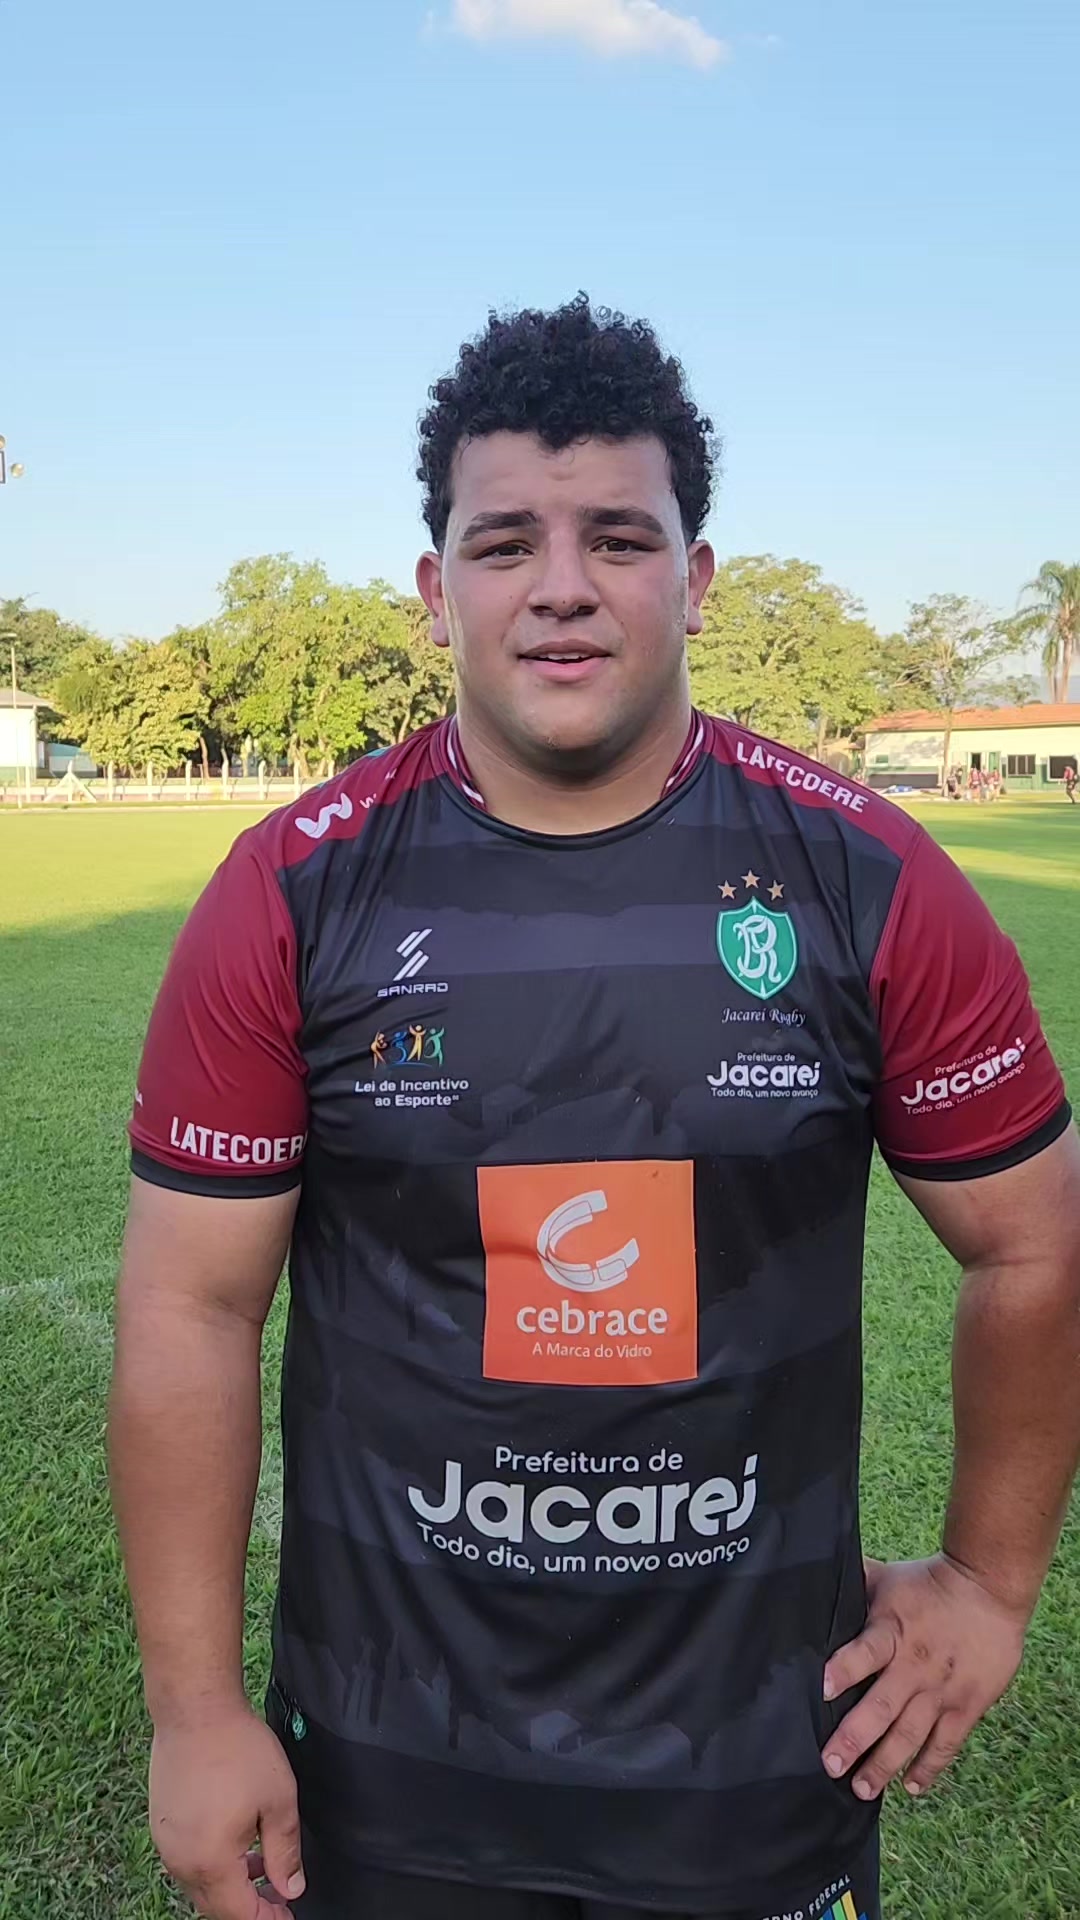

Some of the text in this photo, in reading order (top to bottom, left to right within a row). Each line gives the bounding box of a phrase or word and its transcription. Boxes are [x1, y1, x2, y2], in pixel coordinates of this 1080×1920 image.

[377, 982, 449, 998] SANRAD
[737, 1052, 796, 1062] Prefeitura de
[985, 1045, 998, 1056] de
[355, 1078, 469, 1093] Lei de Incentivo
[710, 1087, 736, 1097] Todo
[755, 1090, 769, 1098] um
[770, 1089, 791, 1098] novo
[375, 1096, 391, 1107] ao
[906, 1104, 933, 1115] Todo
[170, 1116, 308, 1165] LATECOER
[516, 1299, 668, 1337] cebrace
[532, 1342, 652, 1359] A Marca do Vidro
[495, 1446, 684, 1474] Prefeitura de
[416, 1521, 751, 1575] Todo dia, um novo avanço
[808, 1874, 851, 1916] FEDERAL
